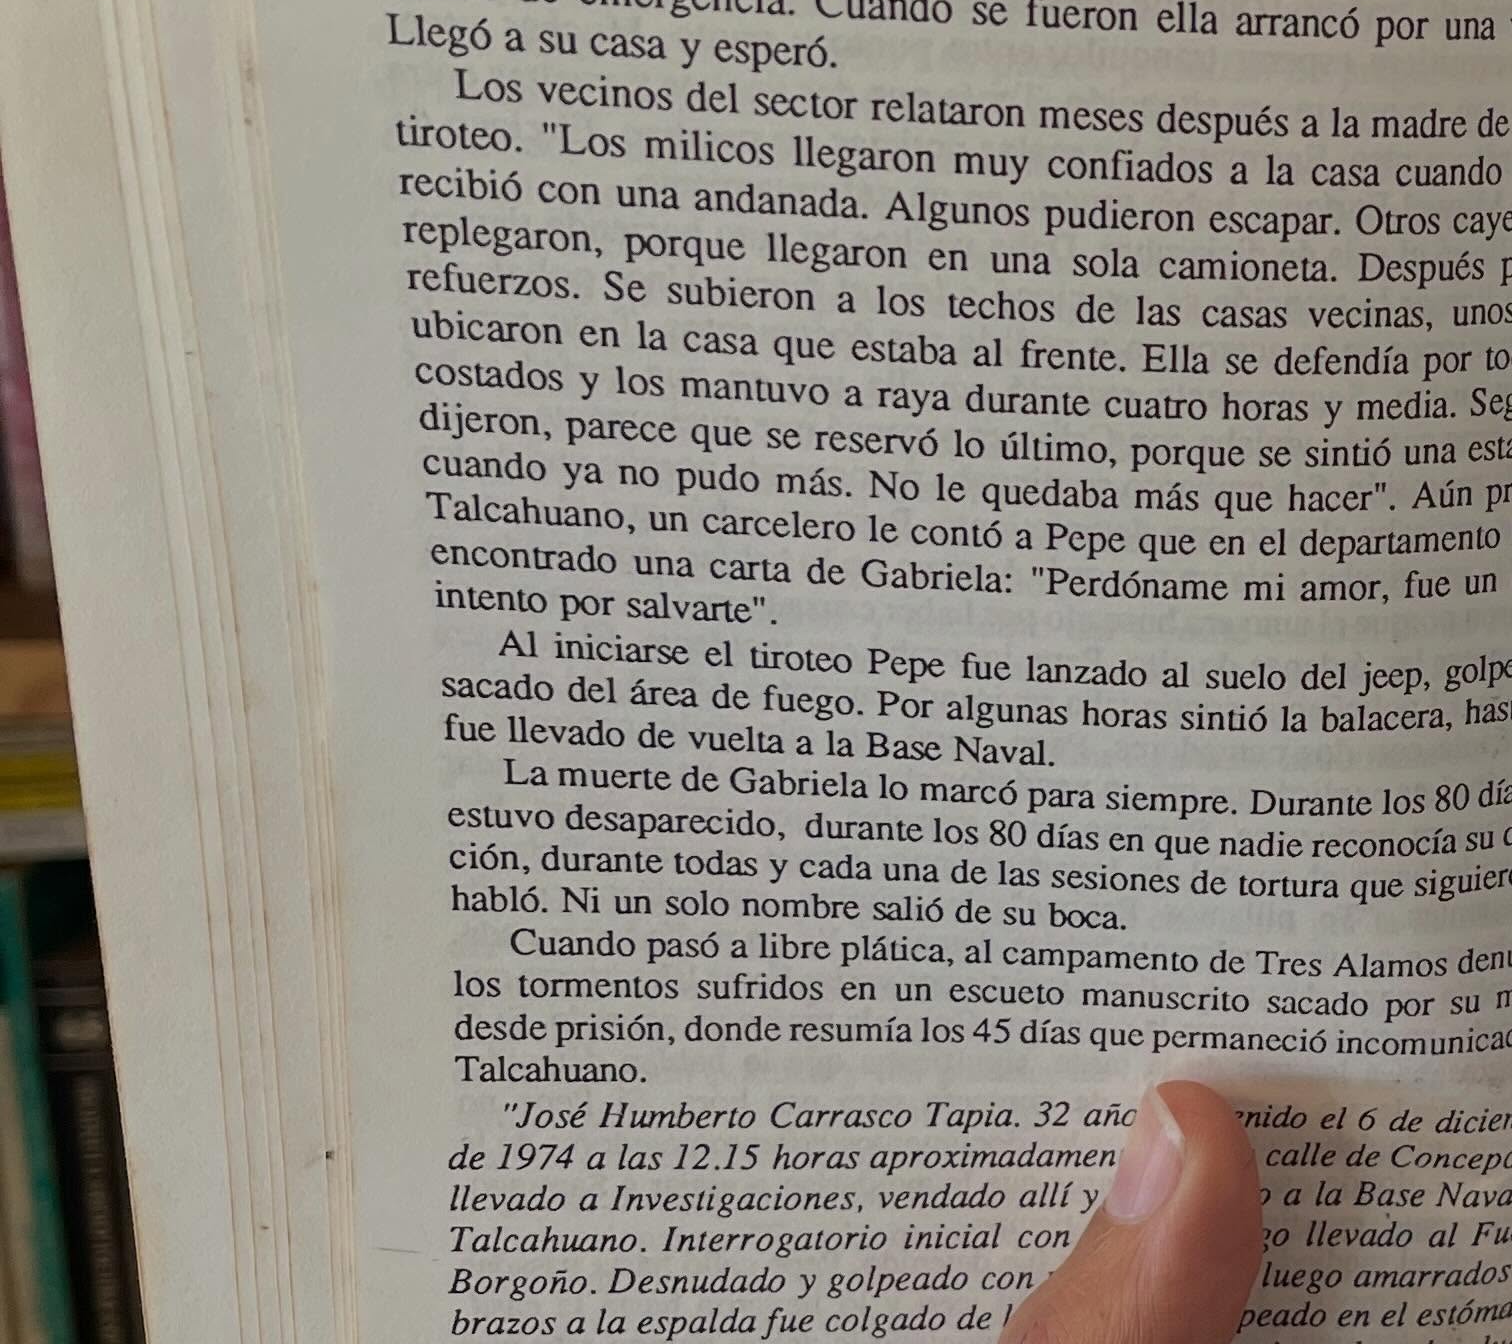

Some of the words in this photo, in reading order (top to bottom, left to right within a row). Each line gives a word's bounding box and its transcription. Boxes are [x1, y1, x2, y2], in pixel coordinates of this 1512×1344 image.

[386, 13, 492, 57] Llegó
[505, 28, 526, 52] a
[539, 30, 578, 54] su
[590, 33, 667, 59] casa
[680, 38, 701, 69] y
[714, 35, 837, 73] esperó.
[425, 492, 635, 534] Talcahuano,
[649, 512, 688, 532] un
[703, 511, 855, 541] carcelero
[868, 514, 898, 543] le
[911, 520, 1002, 548] contó
[1016, 529, 1032, 550] a
[1045, 523, 1126, 560] Pepe
[1139, 534, 1196, 562] que
[1209, 535, 1245, 556] en
[1259, 528, 1286, 556] el
[1300, 526, 1500, 564] departamento
[435, 580, 547, 613] intento
[560, 594, 615, 621] por
[627, 592, 777, 625] salvarte".
[444, 713, 496, 742] fue
[507, 716, 625, 747] llevado
[638, 722, 675, 749] de
[688, 726, 785, 754] vuelta
[796, 736, 818, 756] a
[826, 730, 854, 757] la
[866, 732, 942, 761] Base
[954, 736, 1054, 767] Naval.
[455, 1056, 646, 1083] Talcahuano.
[448, 1143, 485, 1170] de
[497, 1143, 575, 1170] 1974
[587, 1152, 606, 1170] a
[618, 1144, 663, 1170] las
[673, 1144, 760, 1170] 12.15
[773, 1144, 860, 1170] horas
[1266, 1142, 1336, 1167] calle
[1346, 1144, 1380, 1167] de
